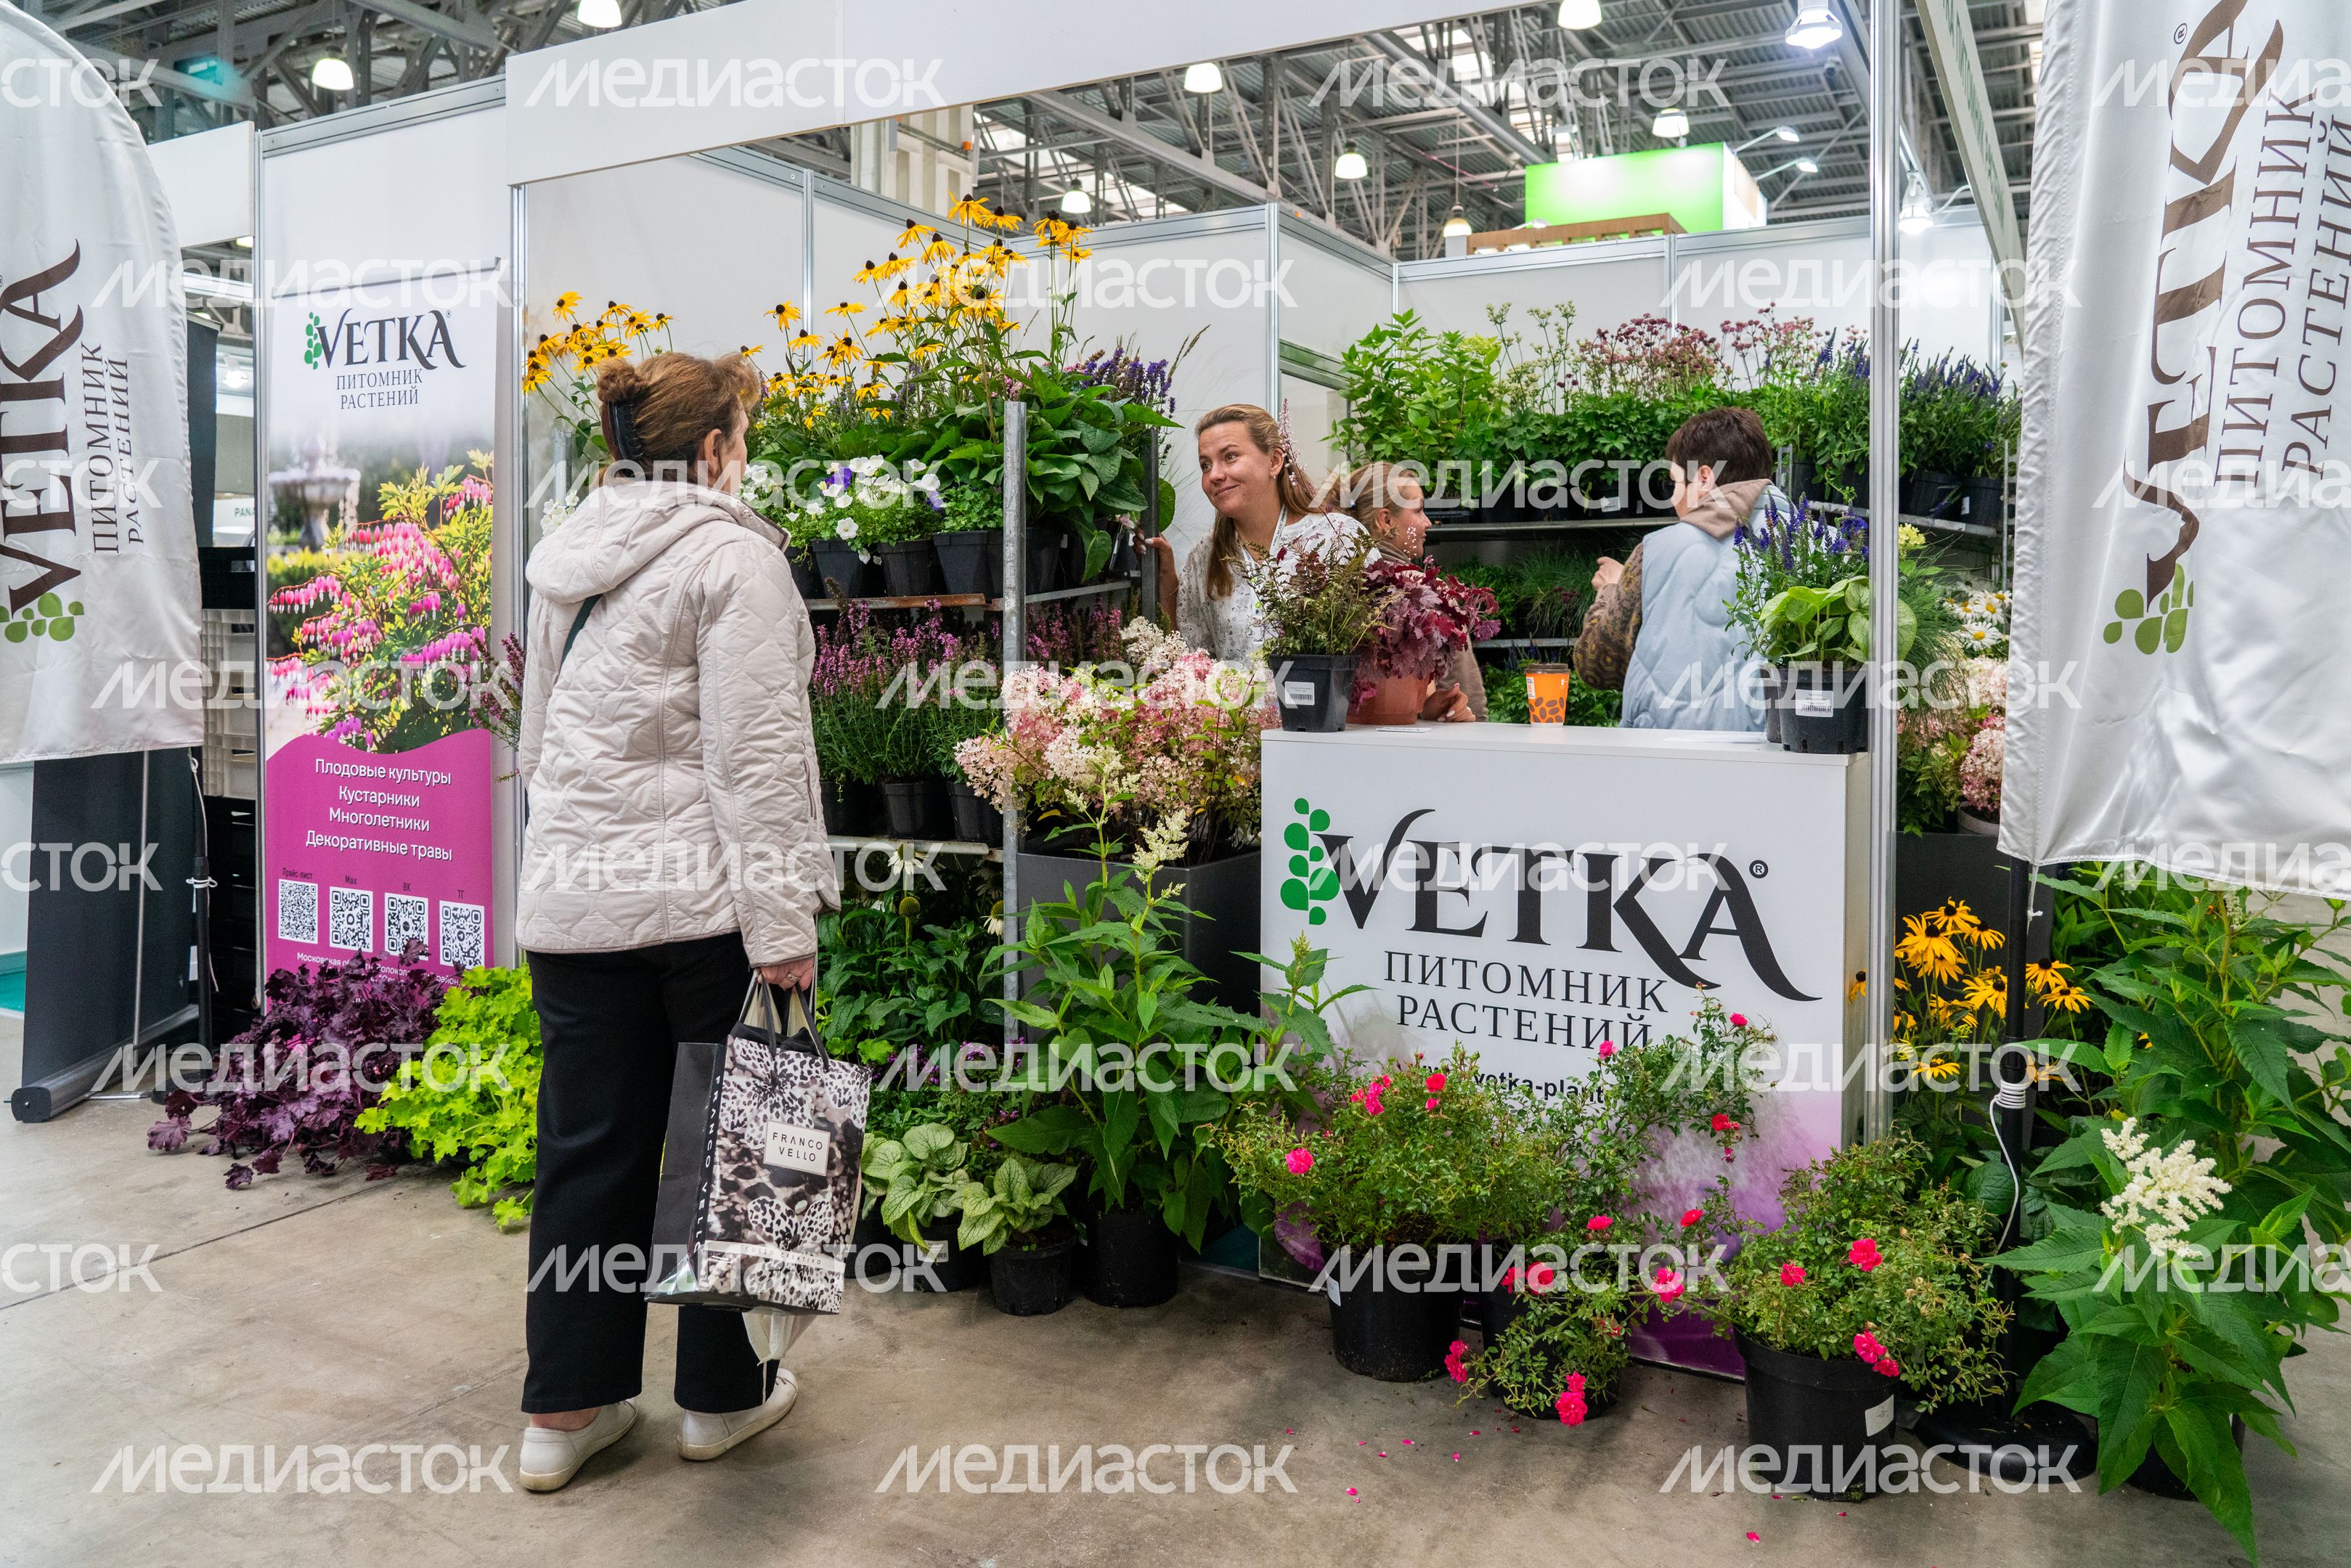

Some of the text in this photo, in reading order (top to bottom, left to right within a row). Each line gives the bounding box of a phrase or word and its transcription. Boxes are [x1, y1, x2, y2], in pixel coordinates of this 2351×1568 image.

[2214, 88, 2317, 488] ПИТОМНИК
[336, 369, 423, 391] ПИТОМНИК
[341, 385, 419, 409] РАСТЕНИЙ
[81, 341, 119, 553] ПИТОМНИК
[105, 357, 144, 545] РАСТЕНИЙ
[315, 759, 452, 787] Плодовые культуры
[339, 785, 420, 808] Кустарники
[329, 807, 431, 832] Многолетники
[306, 830, 453, 861] Декоративные травы
[1384, 950, 1668, 1013] ПИТОМНИК
[1397, 995, 1652, 1050] РАСТЕНИЙ
[773, 1132, 823, 1150] FRANCO
[779, 1146, 816, 1162] VELLO
[693, 1182, 708, 1254] VELLO
